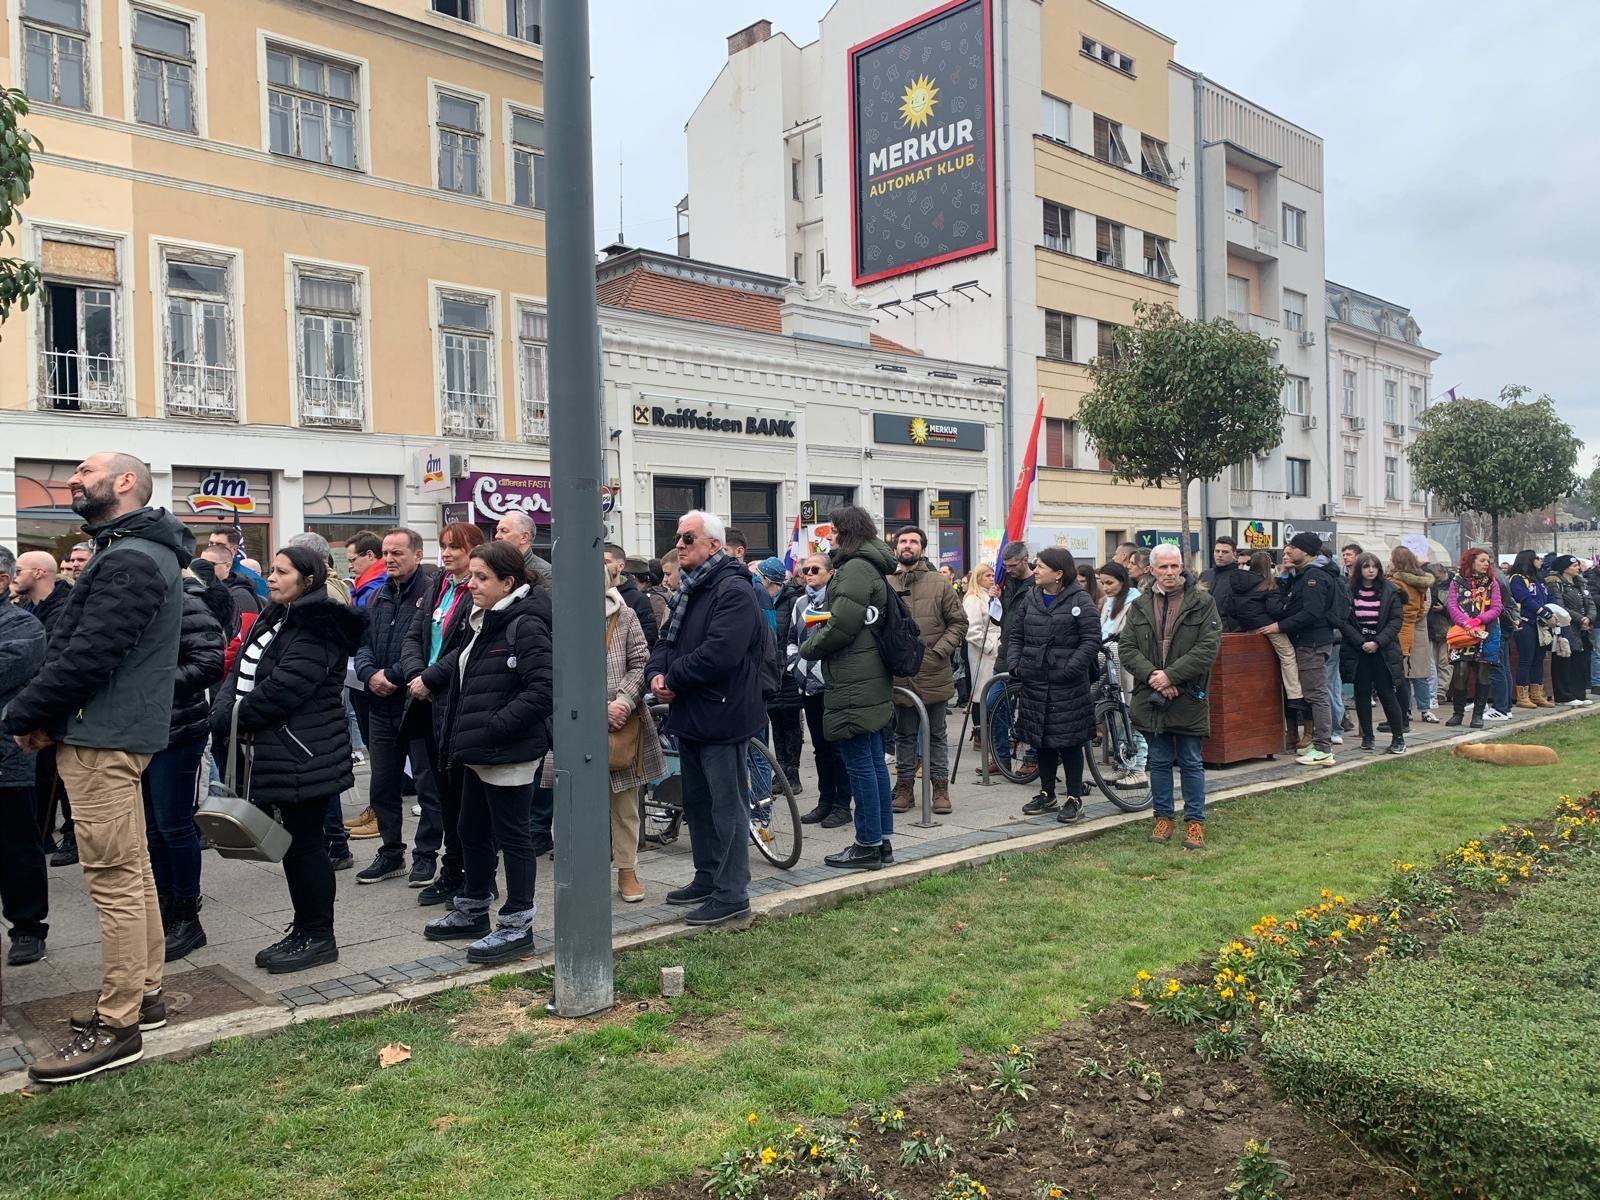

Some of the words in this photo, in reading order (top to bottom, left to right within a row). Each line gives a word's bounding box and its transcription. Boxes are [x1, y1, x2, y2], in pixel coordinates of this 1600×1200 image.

[868, 118, 974, 176] MERKUR
[869, 166, 933, 198] AUTOMAT
[937, 153, 975, 176] KLUB
[651, 406, 743, 433] Raiffeisen
[745, 416, 796, 438] BANK
[929, 424, 958, 435] MERKUR
[426, 453, 441, 473] dm
[202, 471, 247, 497] dm
[498, 478, 527, 488] different
[527, 480, 548, 489] FAST
[472, 476, 552, 521] Cezar
[1253, 534, 1271, 544] SPIN
